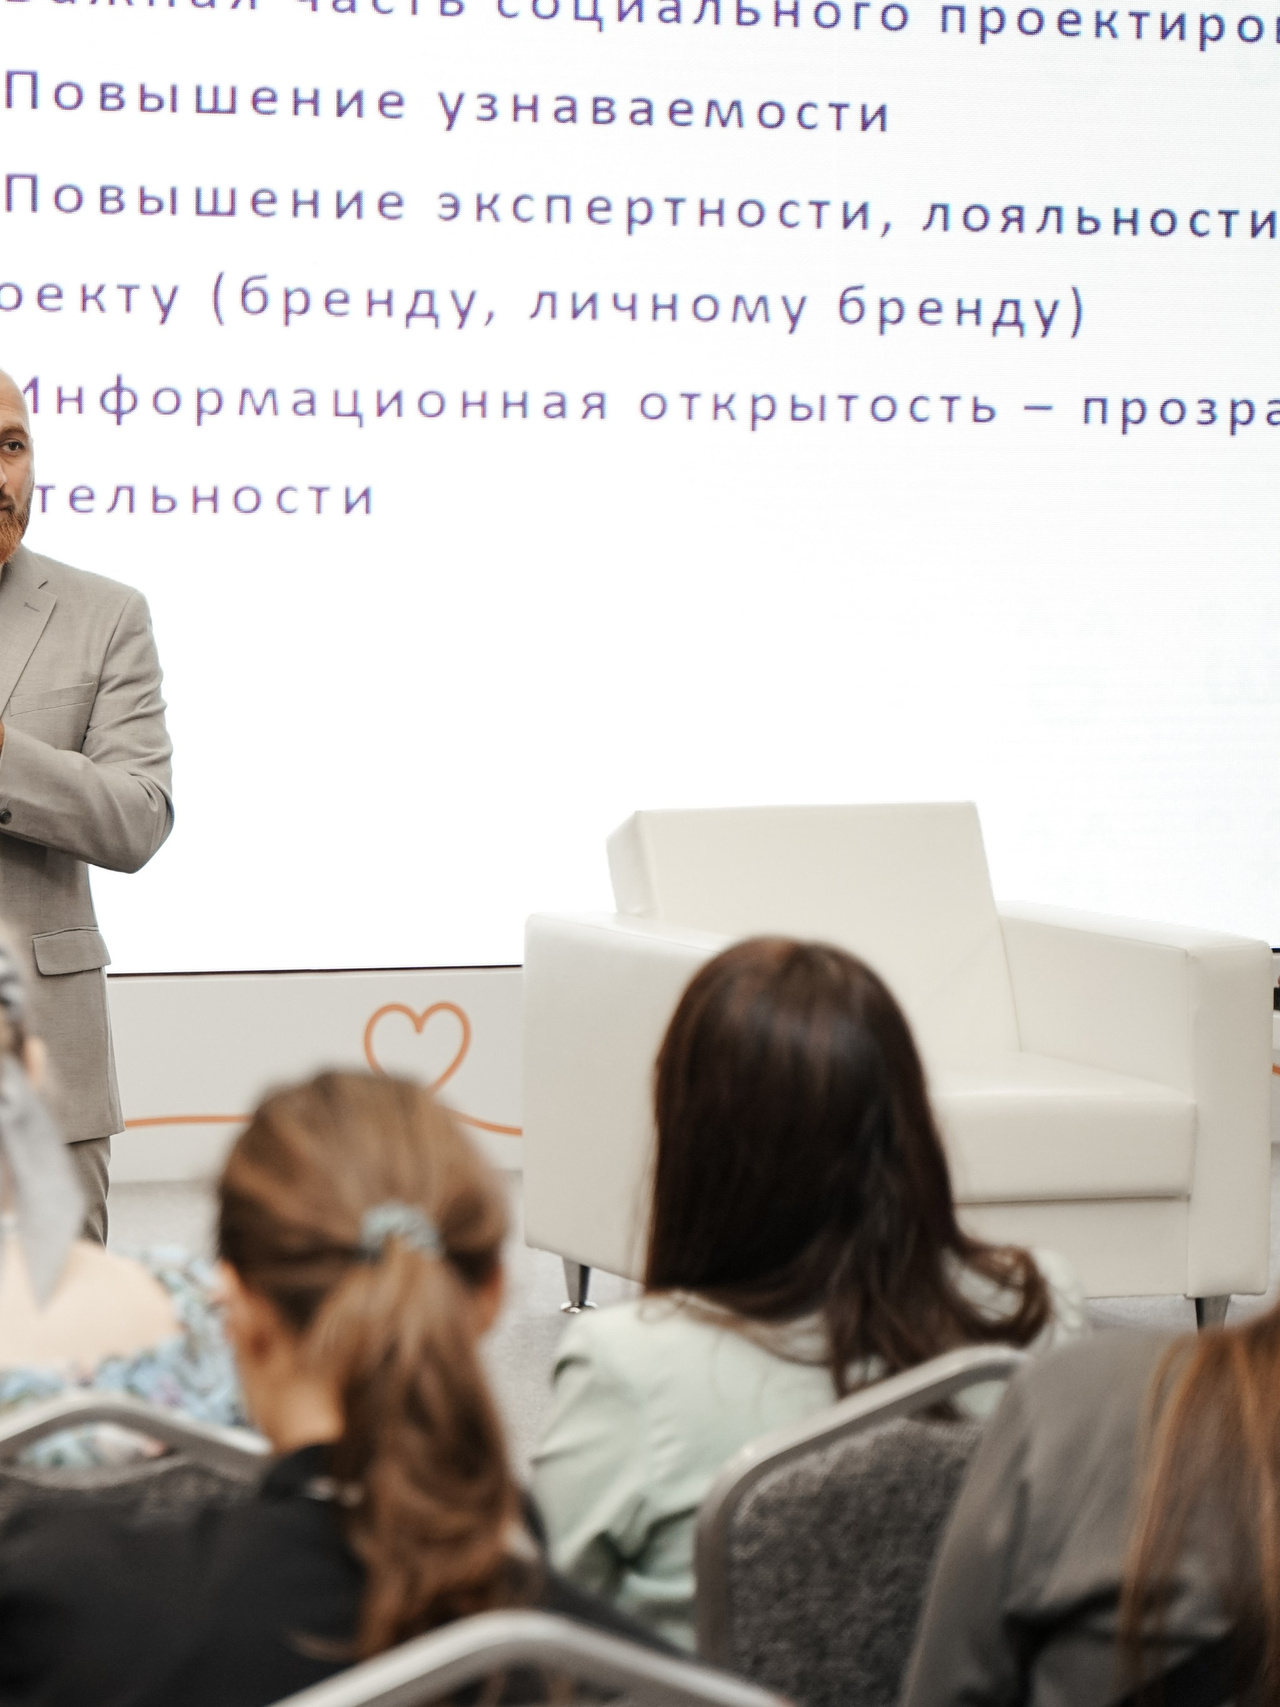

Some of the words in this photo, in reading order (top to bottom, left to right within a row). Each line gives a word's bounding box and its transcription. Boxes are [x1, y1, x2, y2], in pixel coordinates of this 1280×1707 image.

[497, 0, 910, 33] социального
[940, 1, 1280, 53] проектиро
[5, 70, 405, 120] Повышение
[437, 91, 889, 133] узнаваемости
[5, 173, 405, 221] Повышение
[438, 191, 893, 238] экспертности,
[922, 202, 1278, 239] лояльности
[212, 271, 495, 330] (бренду,
[529, 291, 808, 335] личному
[838, 284, 1084, 339] бренду)
[639, 392, 997, 432] открытость
